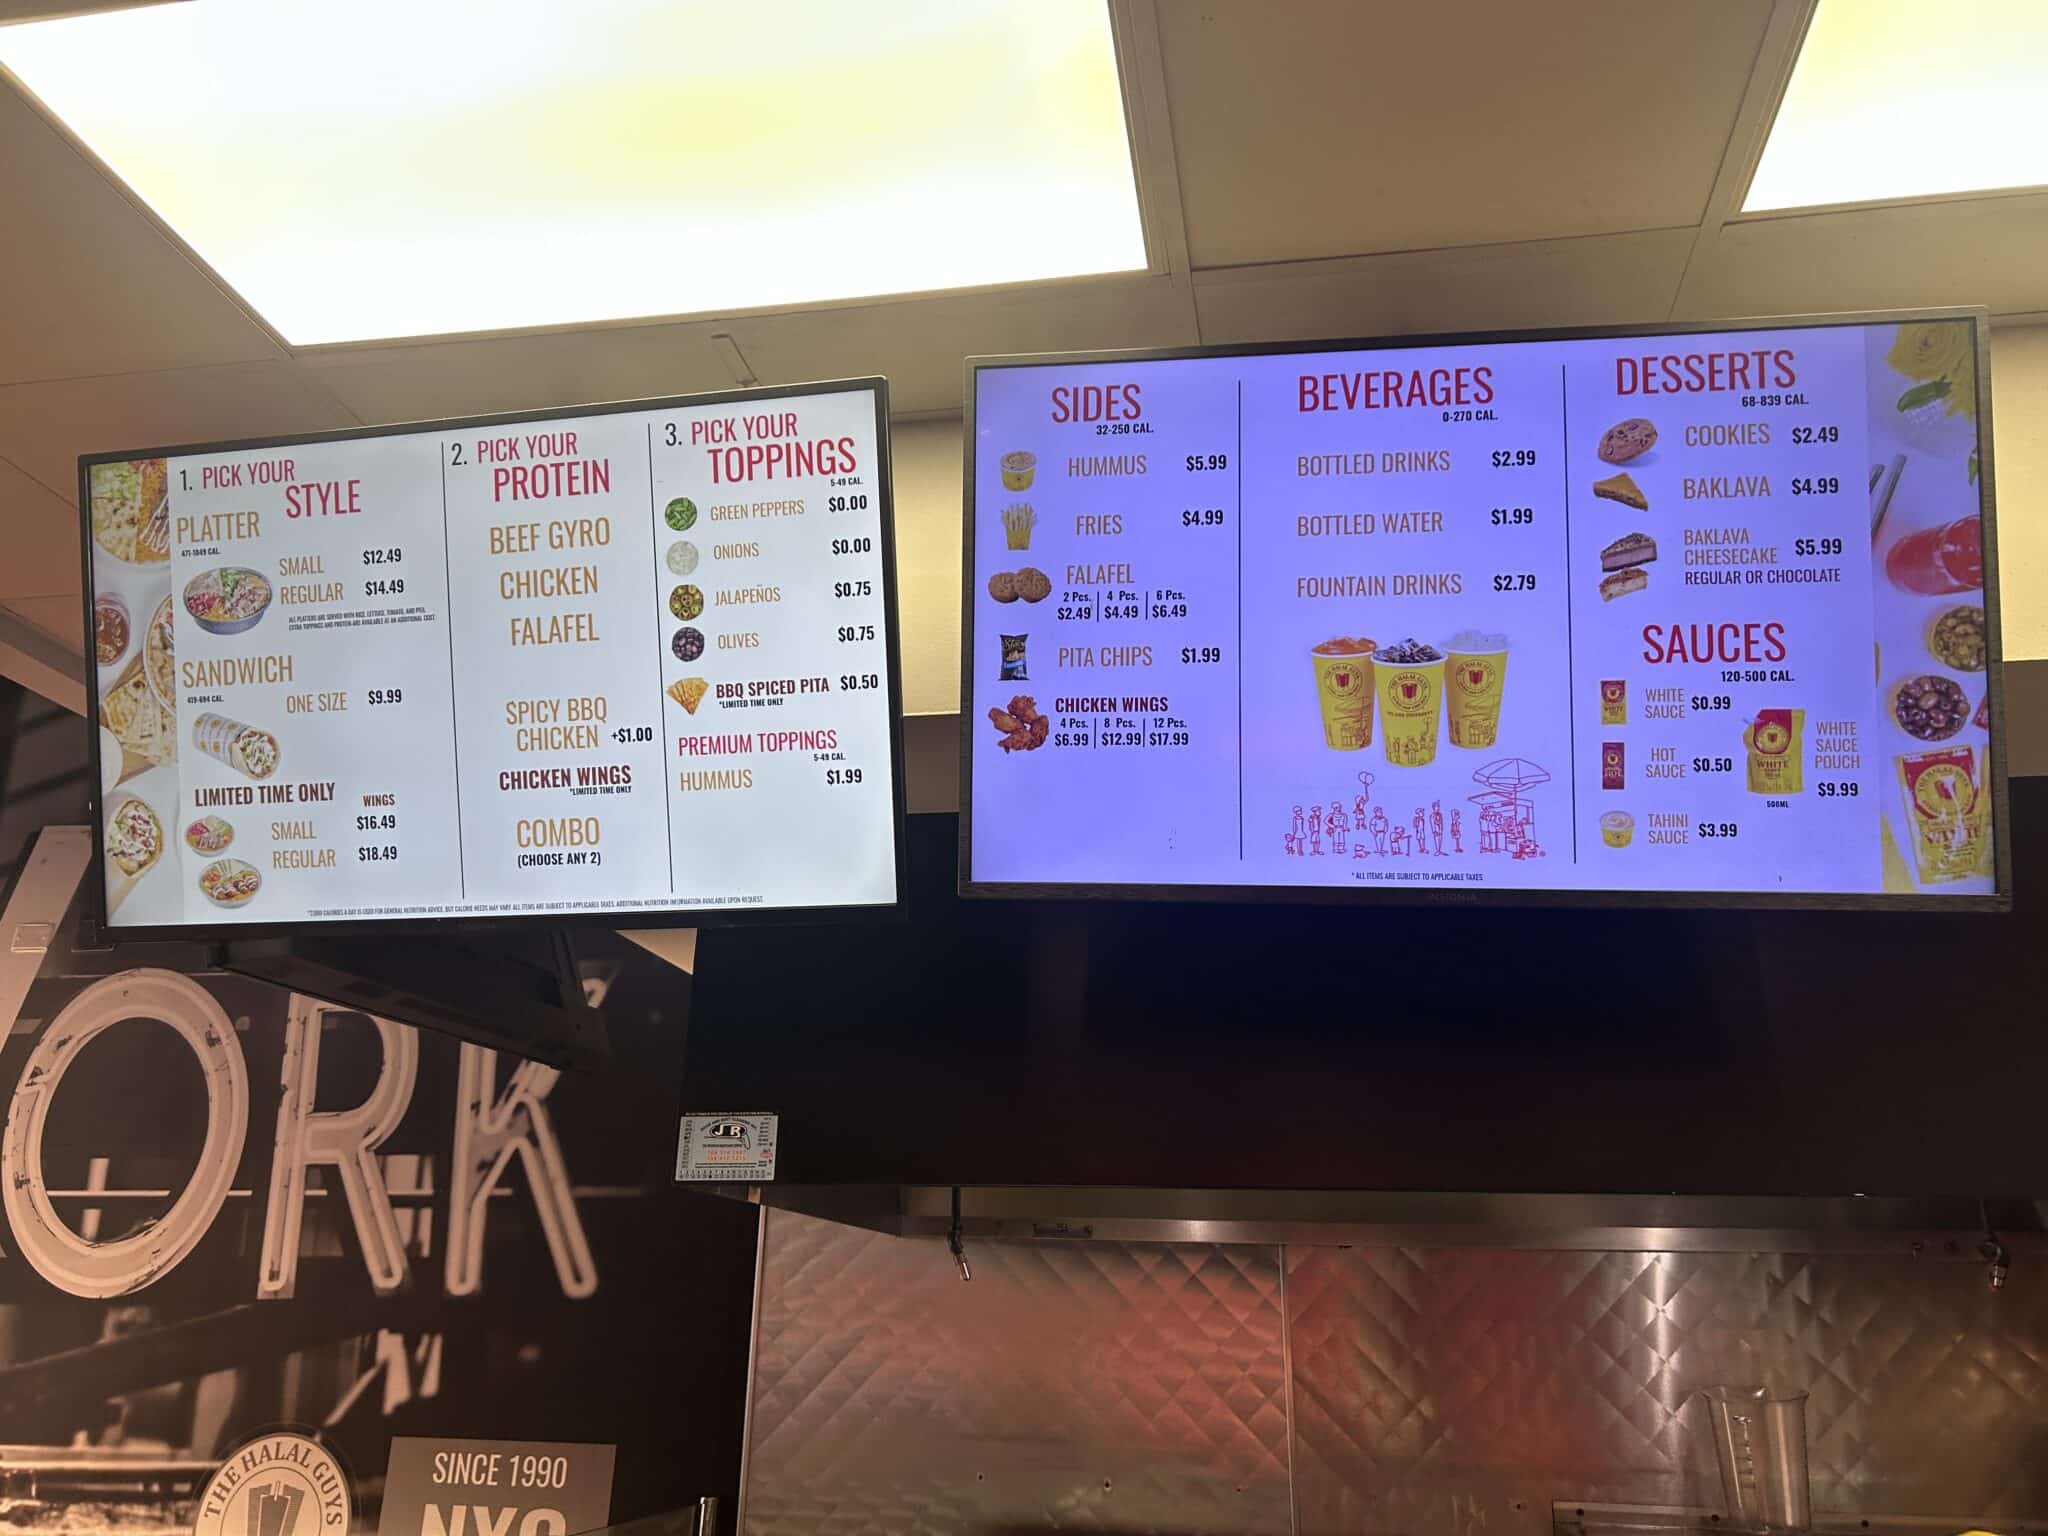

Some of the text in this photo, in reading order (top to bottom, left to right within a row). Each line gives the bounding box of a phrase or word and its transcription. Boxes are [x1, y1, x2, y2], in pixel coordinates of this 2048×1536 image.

[1616, 350, 1795, 395] DESSERTS
[1299, 367, 1493, 412] BEVERAGES
[1052, 384, 1141, 423] SIDES
[1742, 394, 1808, 407] 68-839 CAL.
[1443, 410, 1498, 422] 0-270 CAL.
[665, 413, 798, 446] 3. PICK YOUR
[1096, 423, 1153, 435] 32-250 CAL.
[1685, 424, 1838, 446] COOKIES $2.49
[452, 432, 577, 466] 2. PICK YOUR
[707, 437, 857, 483] TOPPINGS
[1068, 455, 1226, 477] HUMMUS $5.99
[1297, 450, 1536, 477] BOTTLED DRINKS $2.99
[180, 460, 295, 491] 1. PICK YOUR
[494, 459, 610, 502] PROTEIN
[831, 477, 863, 486] 5-49 CAL.
[1683, 476, 1838, 499] BAKLAVA $4.99
[286, 480, 361, 518] STYLE
[711, 495, 867, 521] GREEN PEPPERS $0.00
[177, 512, 260, 544] PLATTER
[1076, 510, 1223, 535] FRIES $4.99
[1297, 508, 1532, 537] BOTTLED WATER $1.99
[490, 517, 610, 554] BEEF GYRO
[1684, 528, 1749, 545] BAKLAVA
[714, 538, 871, 559] ONIONS $0.00
[1684, 548, 1777, 565] CHEESECAKE
[1795, 538, 1842, 556] $5.99
[280, 548, 401, 576] SMALL $12.49
[500, 566, 598, 600] CHICKEN
[1066, 564, 1135, 585] FALAFEL
[1685, 569, 1840, 585] REGULAR OR CHOCOLATE
[281, 580, 404, 604] REGULAR $14.49
[714, 581, 871, 606] JALAPEÑOS $0.75
[1107, 590, 1138, 600] 4 Pcs.
[1156, 590, 1185, 600] 6 Pcs.
[1298, 573, 1536, 598] FOUNTAIN DRINKS $2.79
[1064, 592, 1091, 602] 2 Pcs.
[1058, 606, 1091, 620] $2.49
[1104, 605, 1138, 620] $4.49
[1152, 604, 1186, 618] $6.49
[511, 614, 599, 646] FALAFEL
[718, 626, 874, 649] OLIVES $0.75
[1643, 623, 1786, 664] SAUCES
[1059, 646, 1220, 667] PITA CHIPS $1.99
[182, 655, 292, 688] SANDWICH
[1721, 671, 1794, 682] 120-500 CAL.
[716, 674, 878, 699] BBQ SPICED PITA $0.50
[1645, 688, 1684, 702] WHITE
[287, 689, 401, 713] ONE SIZE $9.99
[506, 697, 607, 724] SPICY BBQ
[750, 699, 765, 707] TIME
[767, 698, 783, 706] ONLY
[1055, 697, 1168, 713] CHICKEN WINGS
[1645, 705, 1685, 718] SAUCE
[1692, 696, 1731, 711] $0.99
[1060, 718, 1088, 728] 4 Pcs.
[1104, 718, 1135, 728] 8 Pcs.
[1154, 718, 1187, 727] 12 Pcs.
[1816, 722, 1857, 735] WHITE
[517, 725, 652, 752] CHICKEN +$1.00
[679, 730, 837, 756] PREMIUM TOPPINGS
[1055, 733, 1089, 746] $6.99
[1102, 733, 1141, 746] $12.99
[1150, 733, 1188, 746] $17.99
[1816, 738, 1858, 752] SAUCE
[1651, 748, 1677, 761] HOT
[1815, 755, 1860, 769] POUCH
[500, 765, 631, 790] CHICKEN WINGS
[1646, 757, 1732, 778] SAUCE $0.50
[680, 769, 862, 791] HUMMUS $1.99
[1818, 782, 1858, 797] $9.99
[195, 783, 335, 807] LIMITED TIME ONLY
[363, 794, 395, 806] WINGS
[272, 815, 395, 840] SMALL $16.49
[1648, 814, 1688, 827] TAHINI
[517, 817, 600, 848] COMBO
[1649, 823, 1737, 844] SAUCE $3.99
[273, 847, 397, 869] REGULAR $18.49
[518, 852, 601, 868] (CHOOSE ANY 2)
[1356, 872, 1366, 880] ALL
[1367, 872, 1382, 880] ITEMS
[1423, 873, 1429, 881] TO
[1431, 873, 1464, 881] APPLICABLE
[433, 1452, 567, 1488] SINCE 1990
[204, 1441, 342, 1525] THE HALAL GUYS
